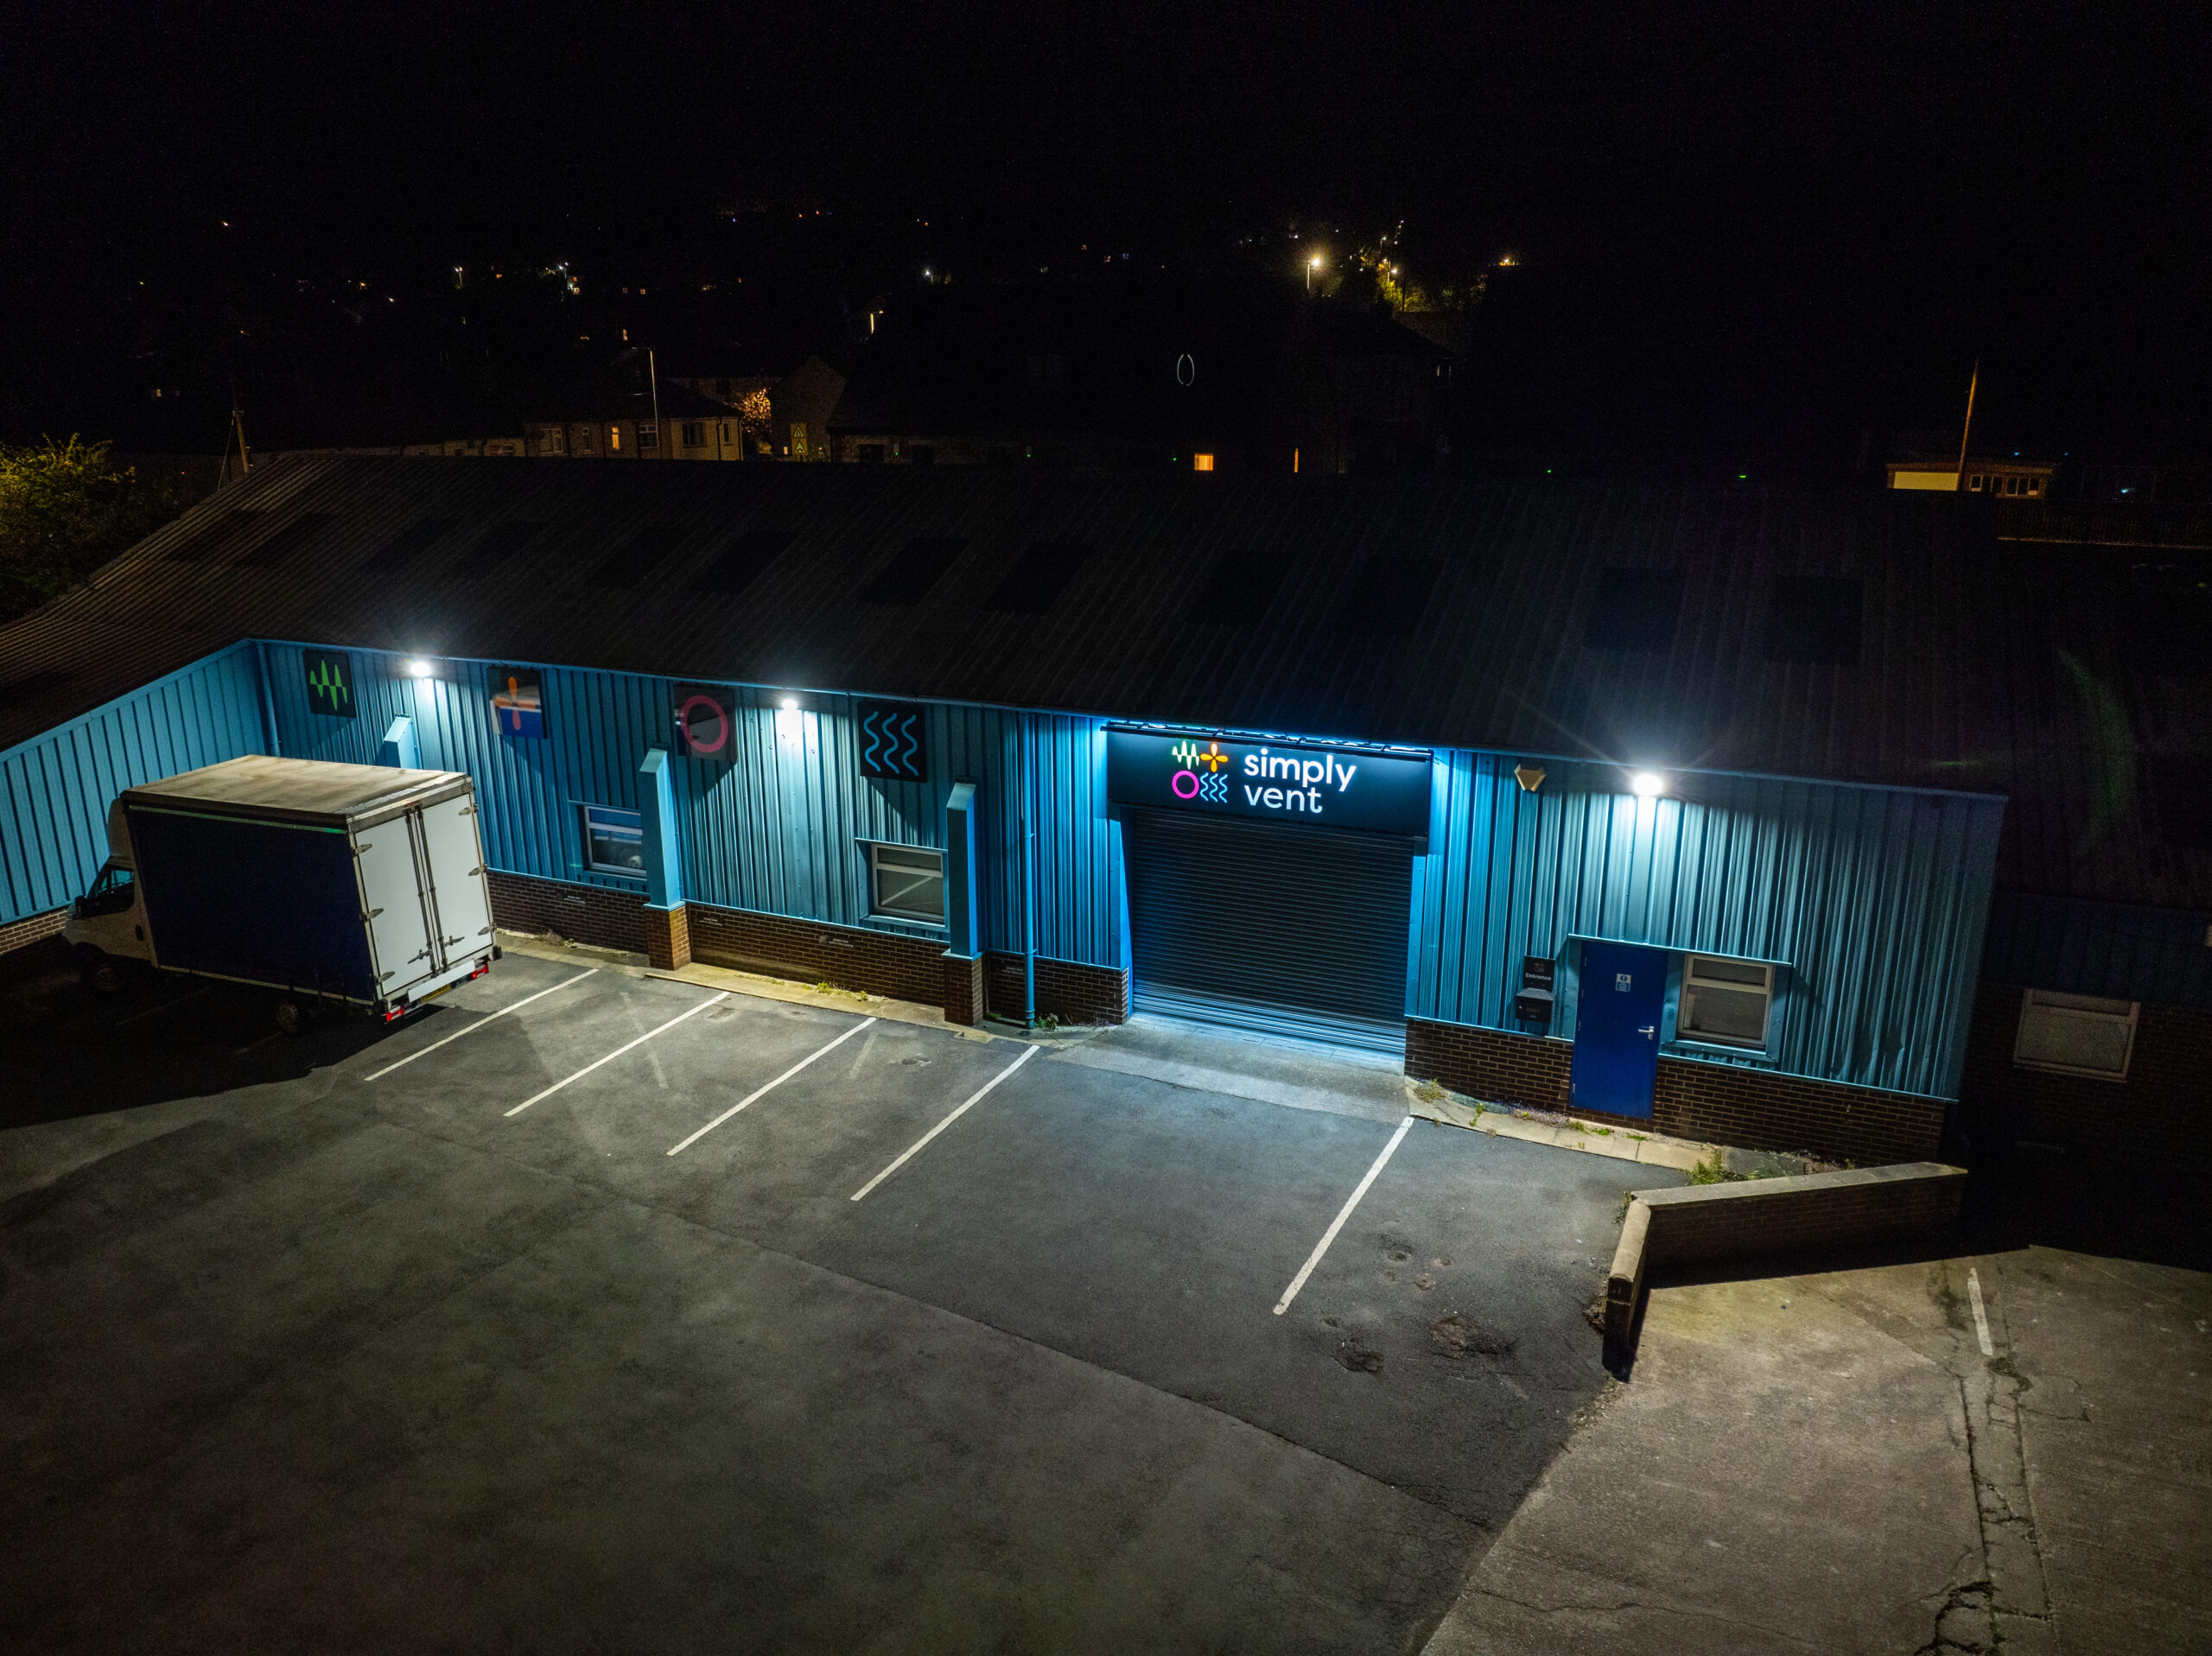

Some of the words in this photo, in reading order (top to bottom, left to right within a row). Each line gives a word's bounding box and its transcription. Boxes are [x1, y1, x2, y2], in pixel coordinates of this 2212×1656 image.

[1244, 748, 1357, 792] simply
[1244, 785, 1323, 813] vent
[1525, 973, 1552, 981] Entrance
